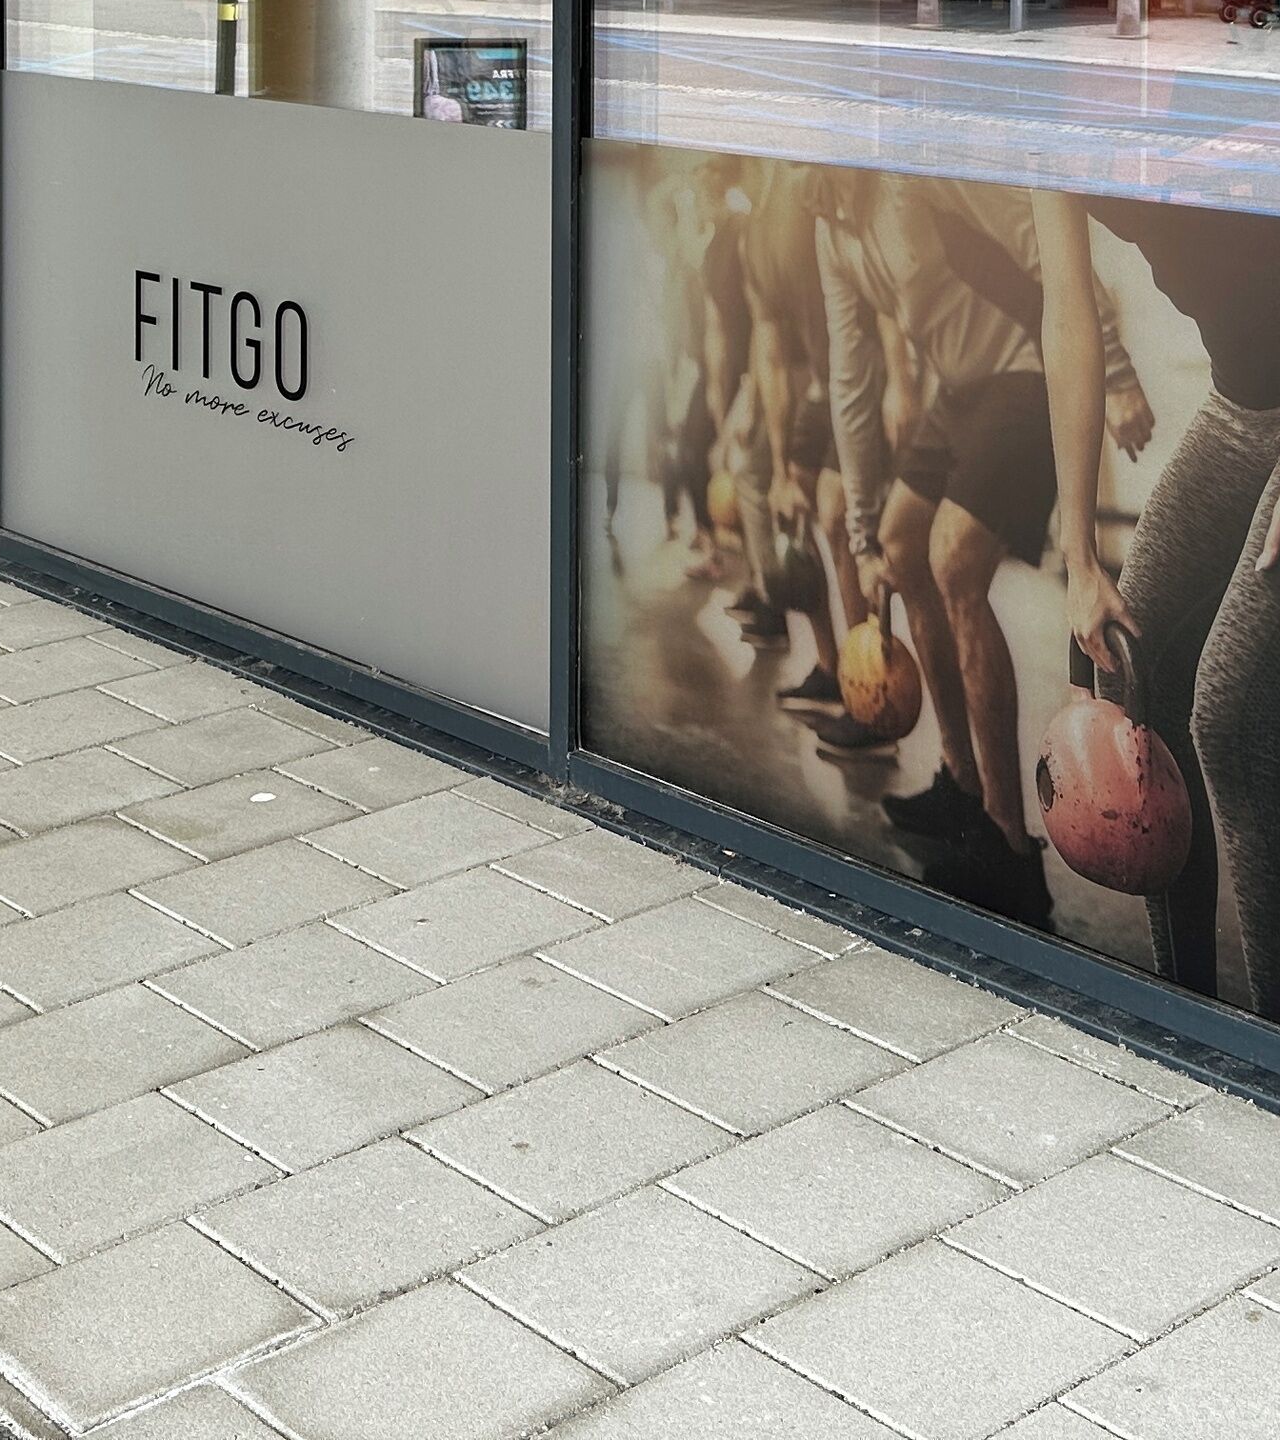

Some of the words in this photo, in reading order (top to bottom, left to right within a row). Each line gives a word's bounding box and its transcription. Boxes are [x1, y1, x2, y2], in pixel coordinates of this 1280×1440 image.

[134, 269, 308, 402] FITGO
[141, 363, 178, 397] No
[184, 389, 250, 417] more
[256, 408, 356, 453] excuses
